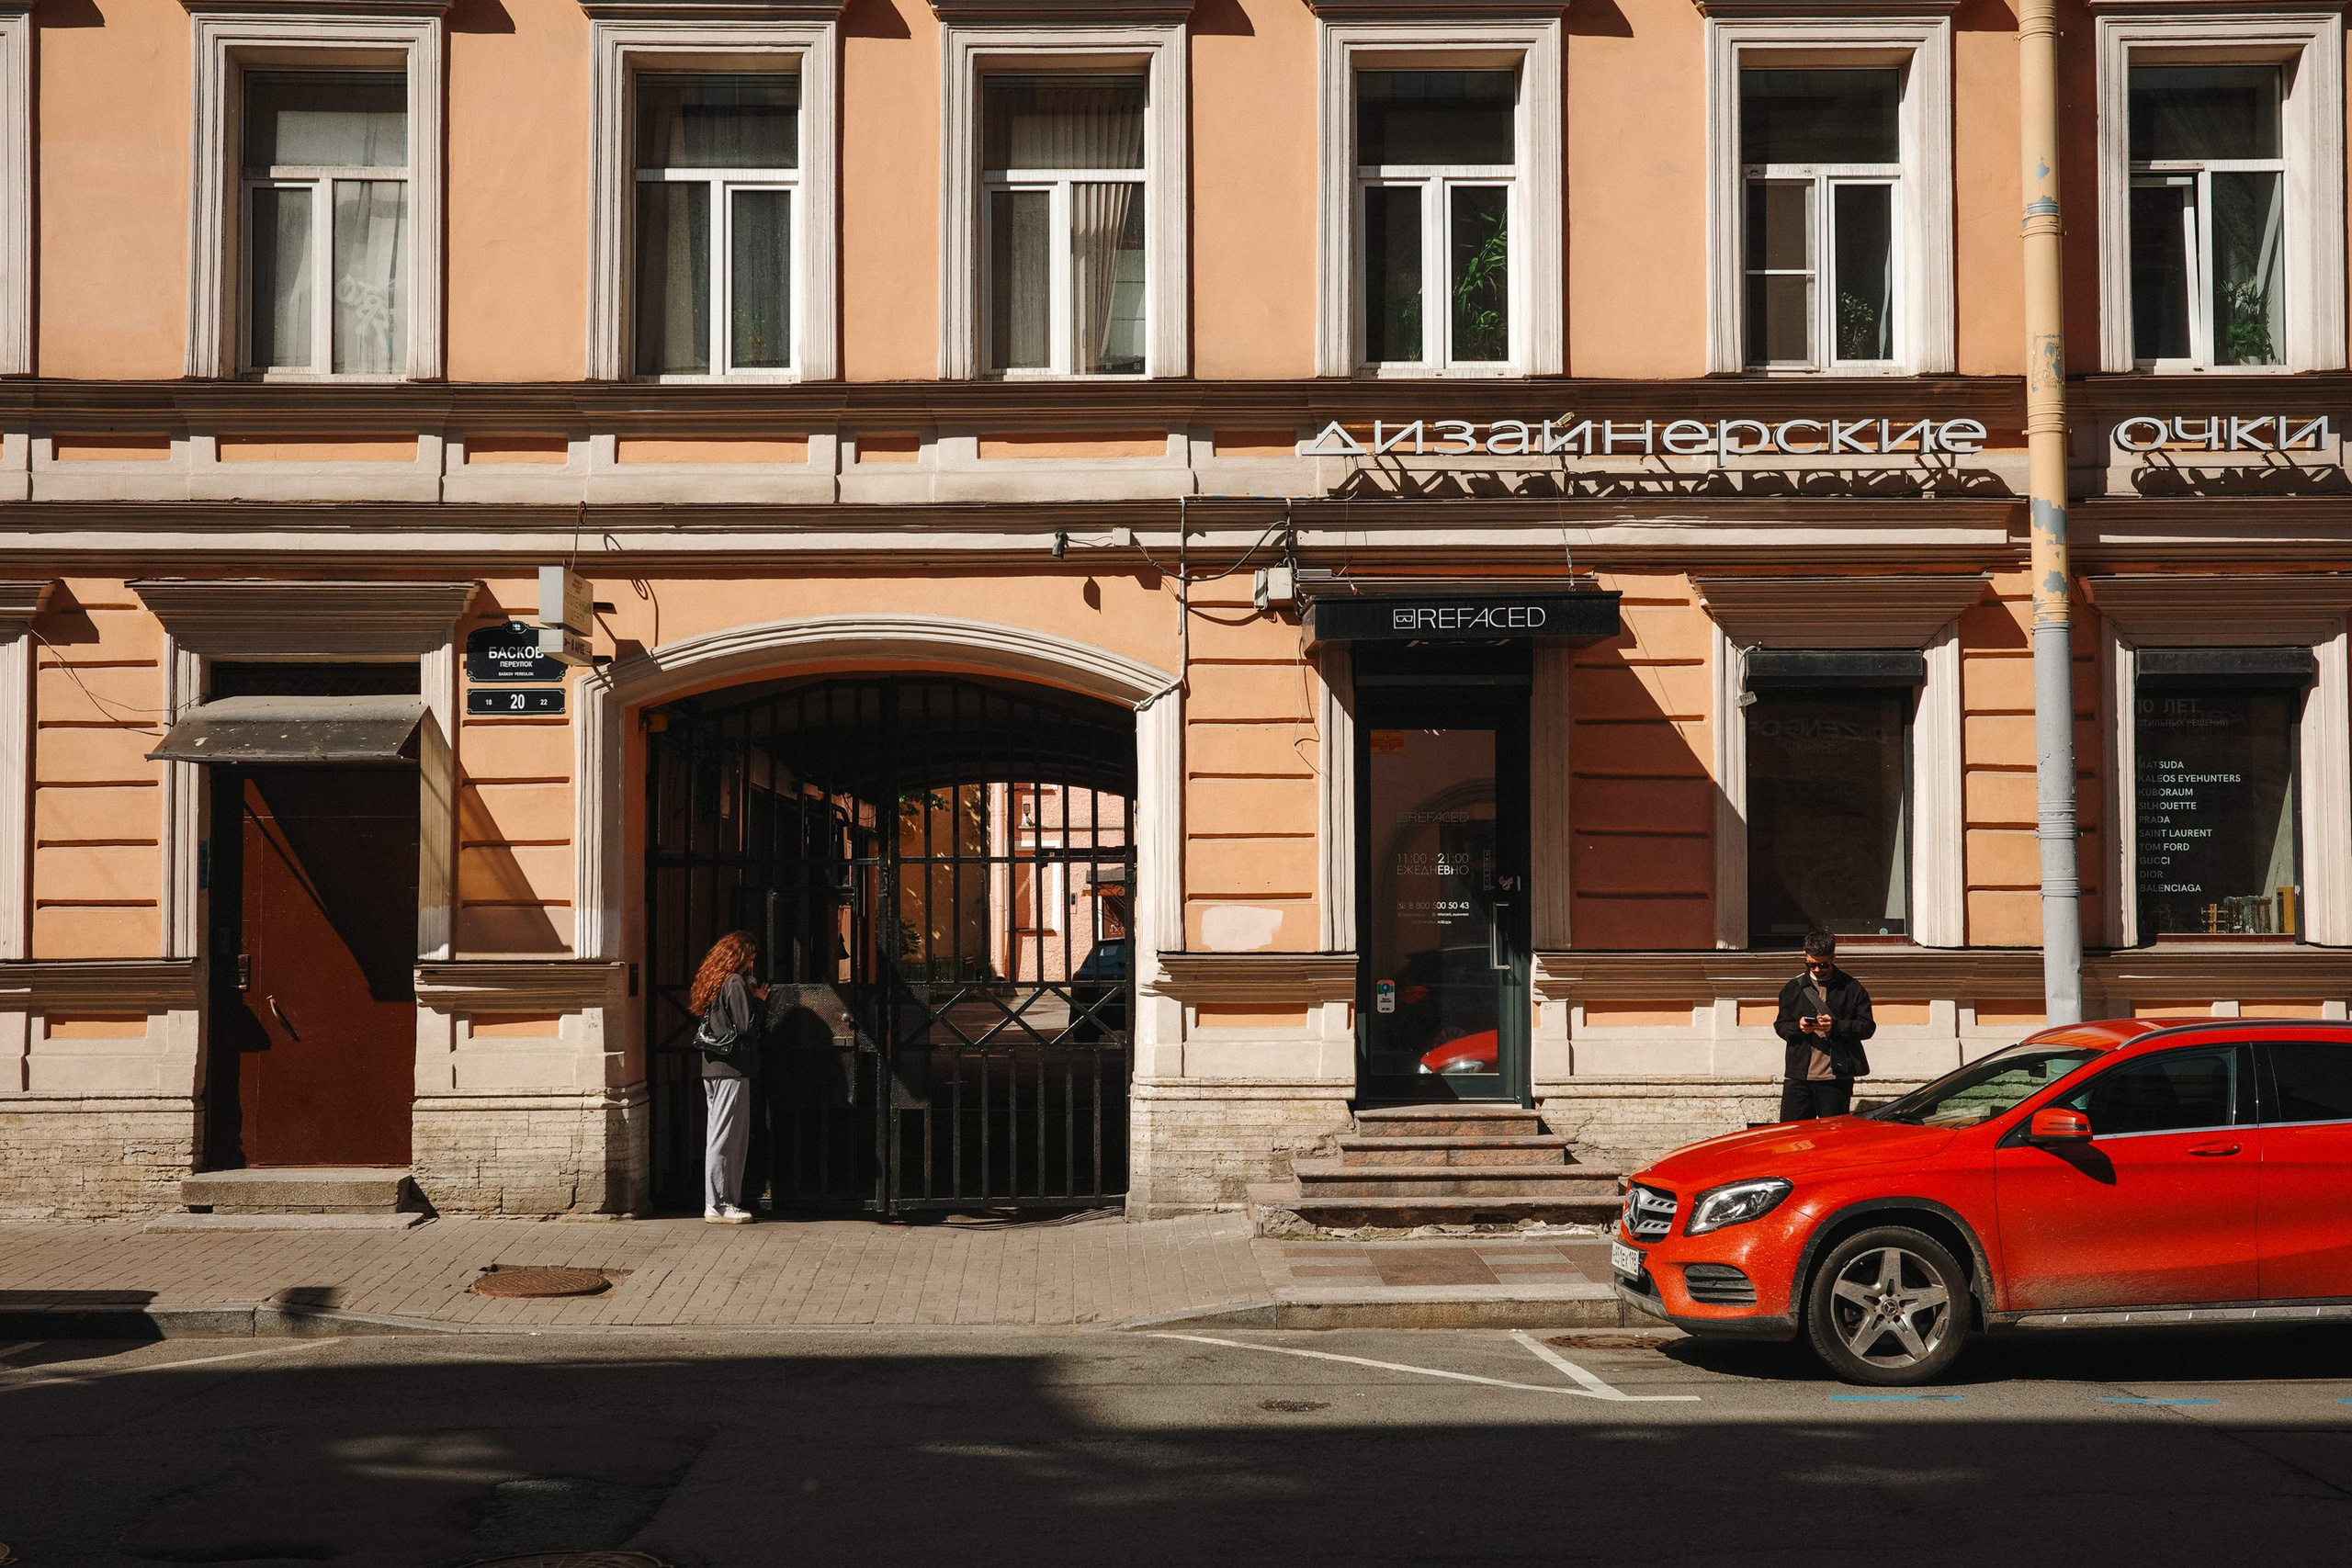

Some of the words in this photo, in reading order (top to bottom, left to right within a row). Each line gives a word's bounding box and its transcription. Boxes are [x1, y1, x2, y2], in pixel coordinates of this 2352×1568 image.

[1418, 606, 1546, 629] REFACED
[488, 646, 544, 659] БАСКОВ
[510, 694, 526, 709] 20
[2136, 699, 2154, 713] 10
[2163, 699, 2199, 713] ЛЕТ
[2138, 761, 2184, 769] MATSUDA
[2138, 774, 2176, 783] KALEOS
[2177, 774, 2241, 783] EYEHUNTERS
[2138, 788, 2193, 796] KUBORAUM
[2139, 802, 2197, 810] SILHOUETTE
[1408, 812, 1469, 823] REFACED
[2139, 829, 2166, 838] SAINT
[2169, 829, 2212, 838] LAURENT
[1397, 853, 1427, 863] 11:00
[1437, 852, 1469, 863] 21:00
[2140, 856, 2170, 864] GUCCI
[1396, 864, 1469, 875] ЕЖЕДНЕВНО
[2140, 884, 2202, 892] BALENCIAGA
[1408, 901, 1414, 909] 8
[1416, 901, 1430, 909] 800
[1432, 901, 1446, 909] 500
[1448, 901, 1458, 909] 50
[1459, 901, 1469, 909] 43
